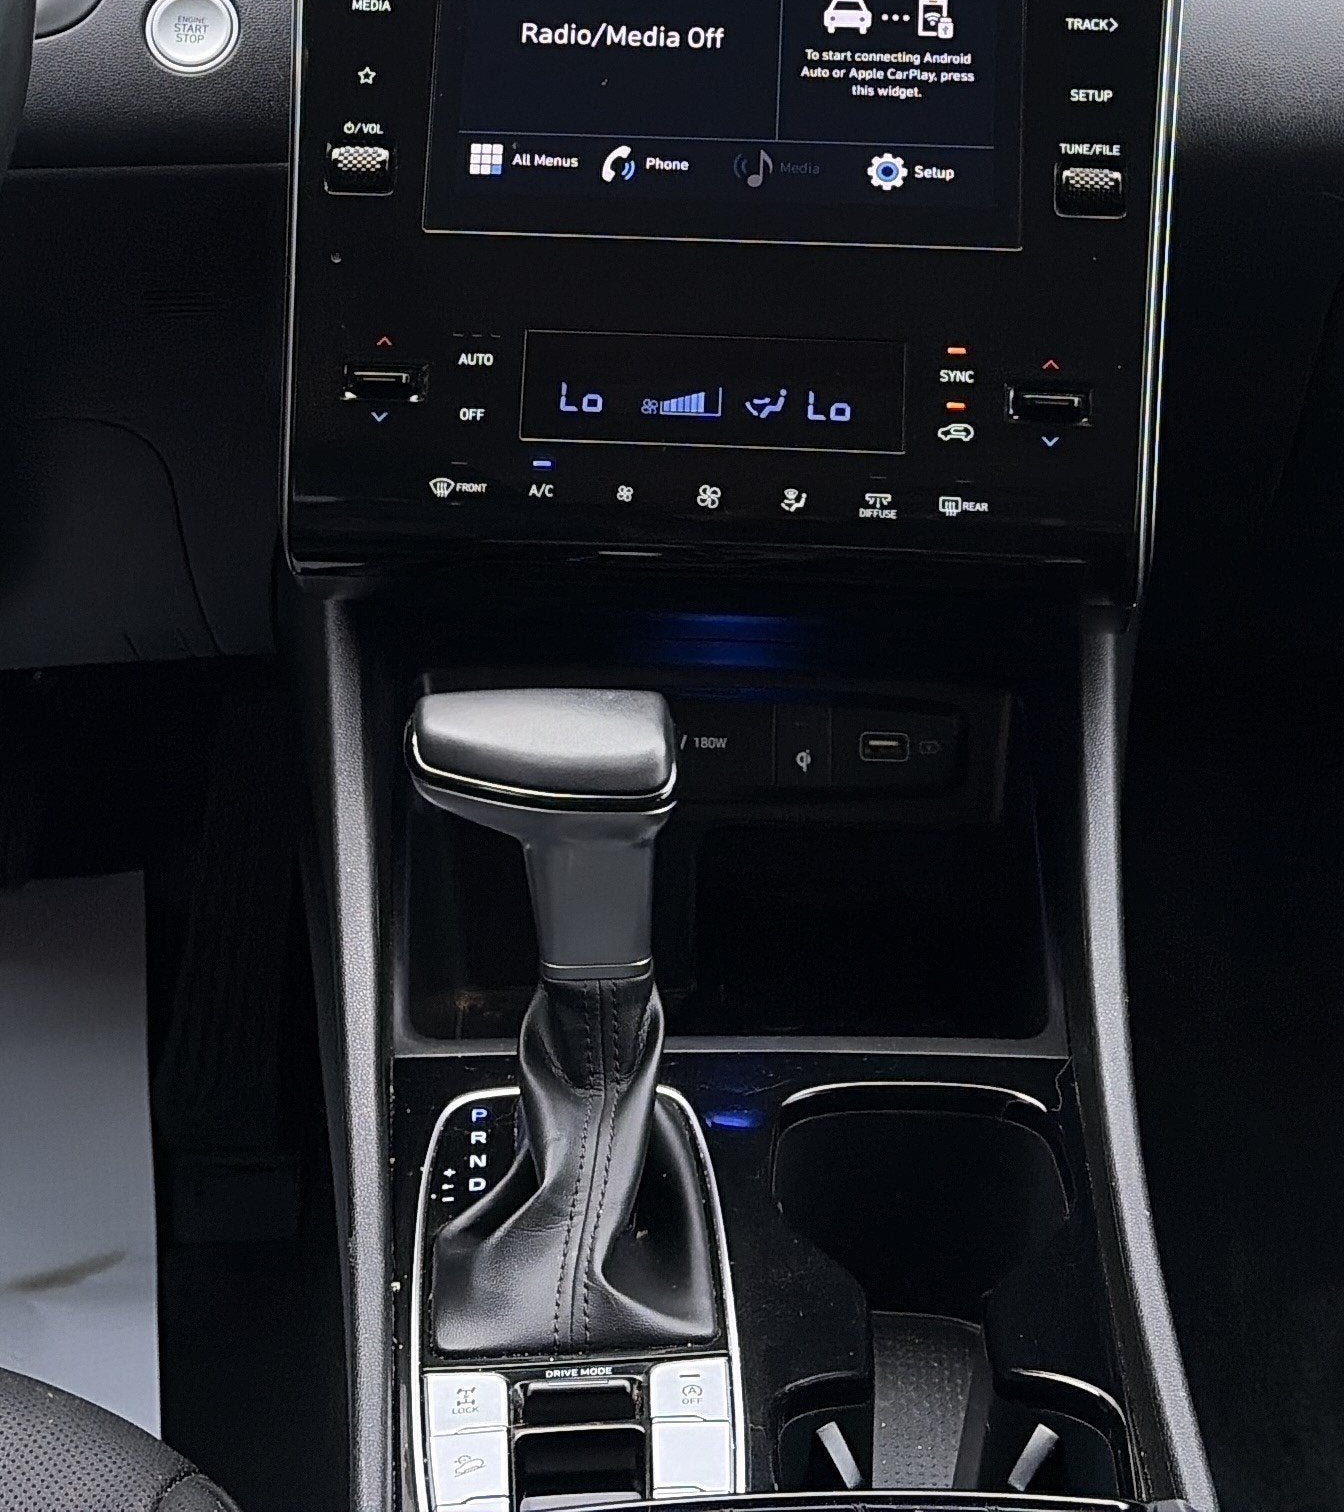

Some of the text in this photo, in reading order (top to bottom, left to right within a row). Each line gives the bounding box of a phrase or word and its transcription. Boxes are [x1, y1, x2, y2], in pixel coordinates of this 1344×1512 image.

[177, 15, 206, 23] ENGINE
[174, 23, 209, 34] START
[521, 22, 725, 49] Radio/Media Off
[176, 33, 205, 44] STOP
[805, 48, 972, 65] To start connecting Android
[800, 66, 830, 78] Auto
[832, 69, 846, 78] or
[849, 67, 884, 80] Apple
[940, 70, 975, 83] press
[851, 85, 922, 99] this widget.
[1070, 89, 1113, 102] SETUP
[1059, 143, 1121, 156] TUNE/FILE
[512, 153, 579, 168] All Menus
[645, 157, 689, 171] Phone
[780, 162, 820, 174] Media
[914, 165, 955, 182] Setup
[457, 352, 494, 366] AUTO
[939, 369, 975, 384] SYNC
[559, 381, 604, 413] Lo
[807, 390, 851, 422] Lo
[459, 407, 486, 421] OFF
[456, 482, 488, 493] FRONT
[528, 483, 555, 498] A/C
[858, 508, 898, 519] DIFFUSE
[962, 501, 989, 512] REAR
[693, 736, 728, 749] 180W
[471, 1108, 488, 1123] P
[470, 1130, 487, 1145] R
[469, 1154, 487, 1169] N
[468, 1177, 487, 1192] D
[545, 1366, 613, 1378] DRIVE MODE
[452, 1406, 479, 1415] LOCK
